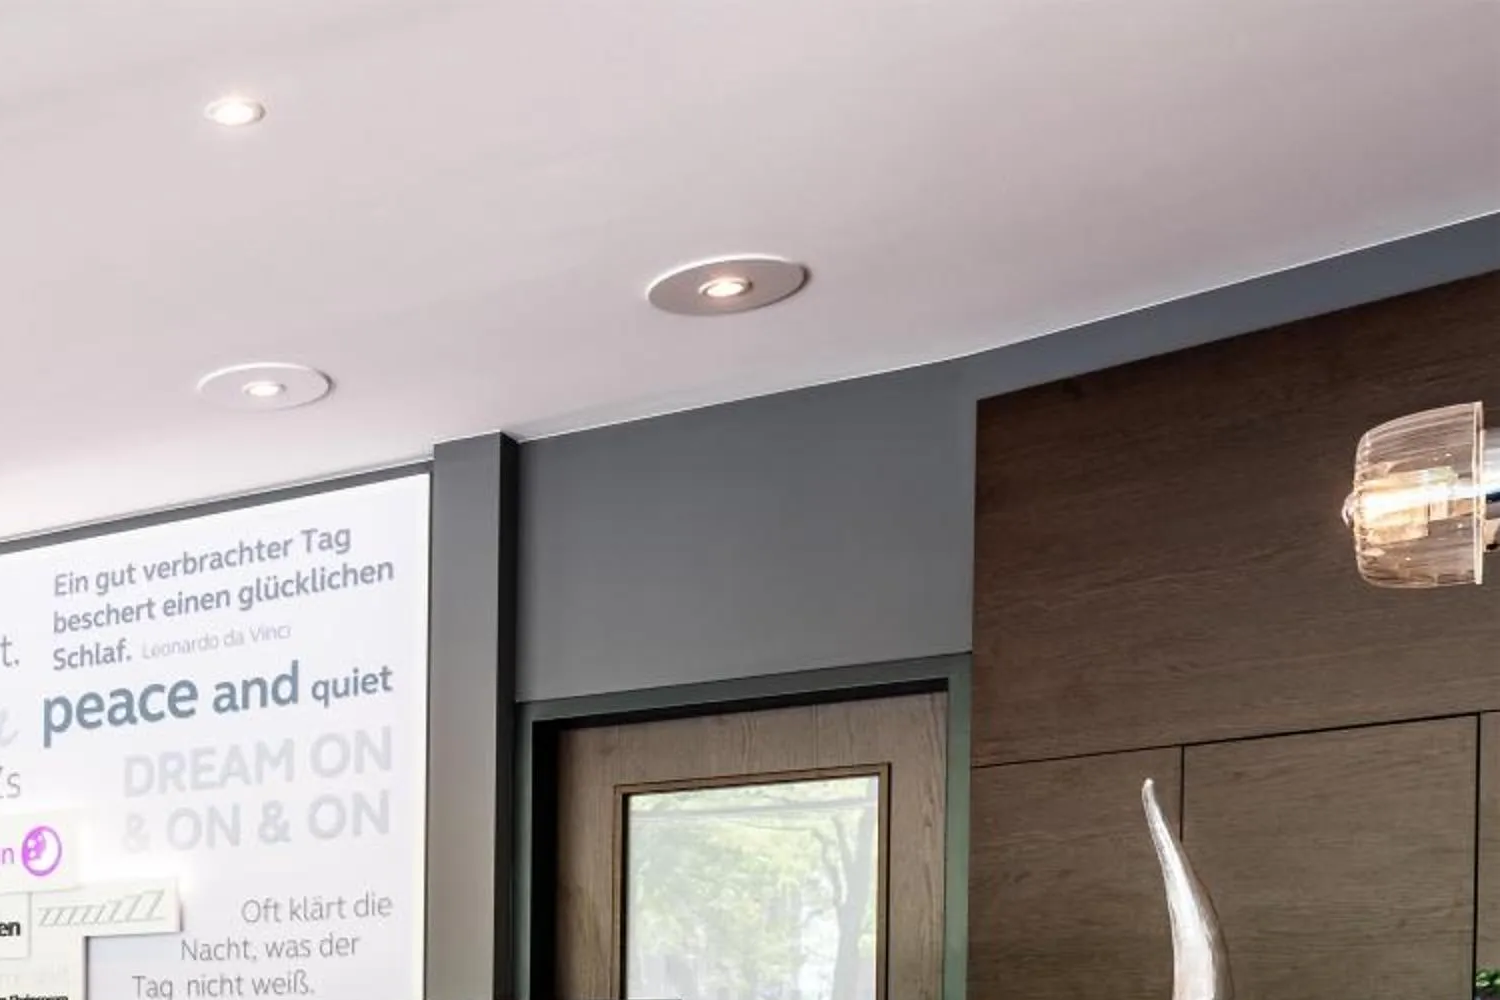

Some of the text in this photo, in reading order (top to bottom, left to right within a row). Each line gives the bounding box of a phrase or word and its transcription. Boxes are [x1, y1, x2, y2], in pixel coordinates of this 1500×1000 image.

[54, 528, 351, 596] Ein gut verbrachter Tag
[54, 559, 394, 633] beschert einen glücklichen
[53, 638, 132, 670] Schlaf.
[142, 635, 218, 659] Leonardo
[224, 631, 244, 648] da
[43, 660, 393, 748] peace and quiet
[123, 726, 392, 798] DREAM ON
[121, 790, 390, 853] & ON & ON
[241, 894, 393, 924] Oft klärt die
[181, 933, 361, 962] Nacht, was der
[187, 973, 245, 996] nicht
[252, 970, 315, 995] weiß.
